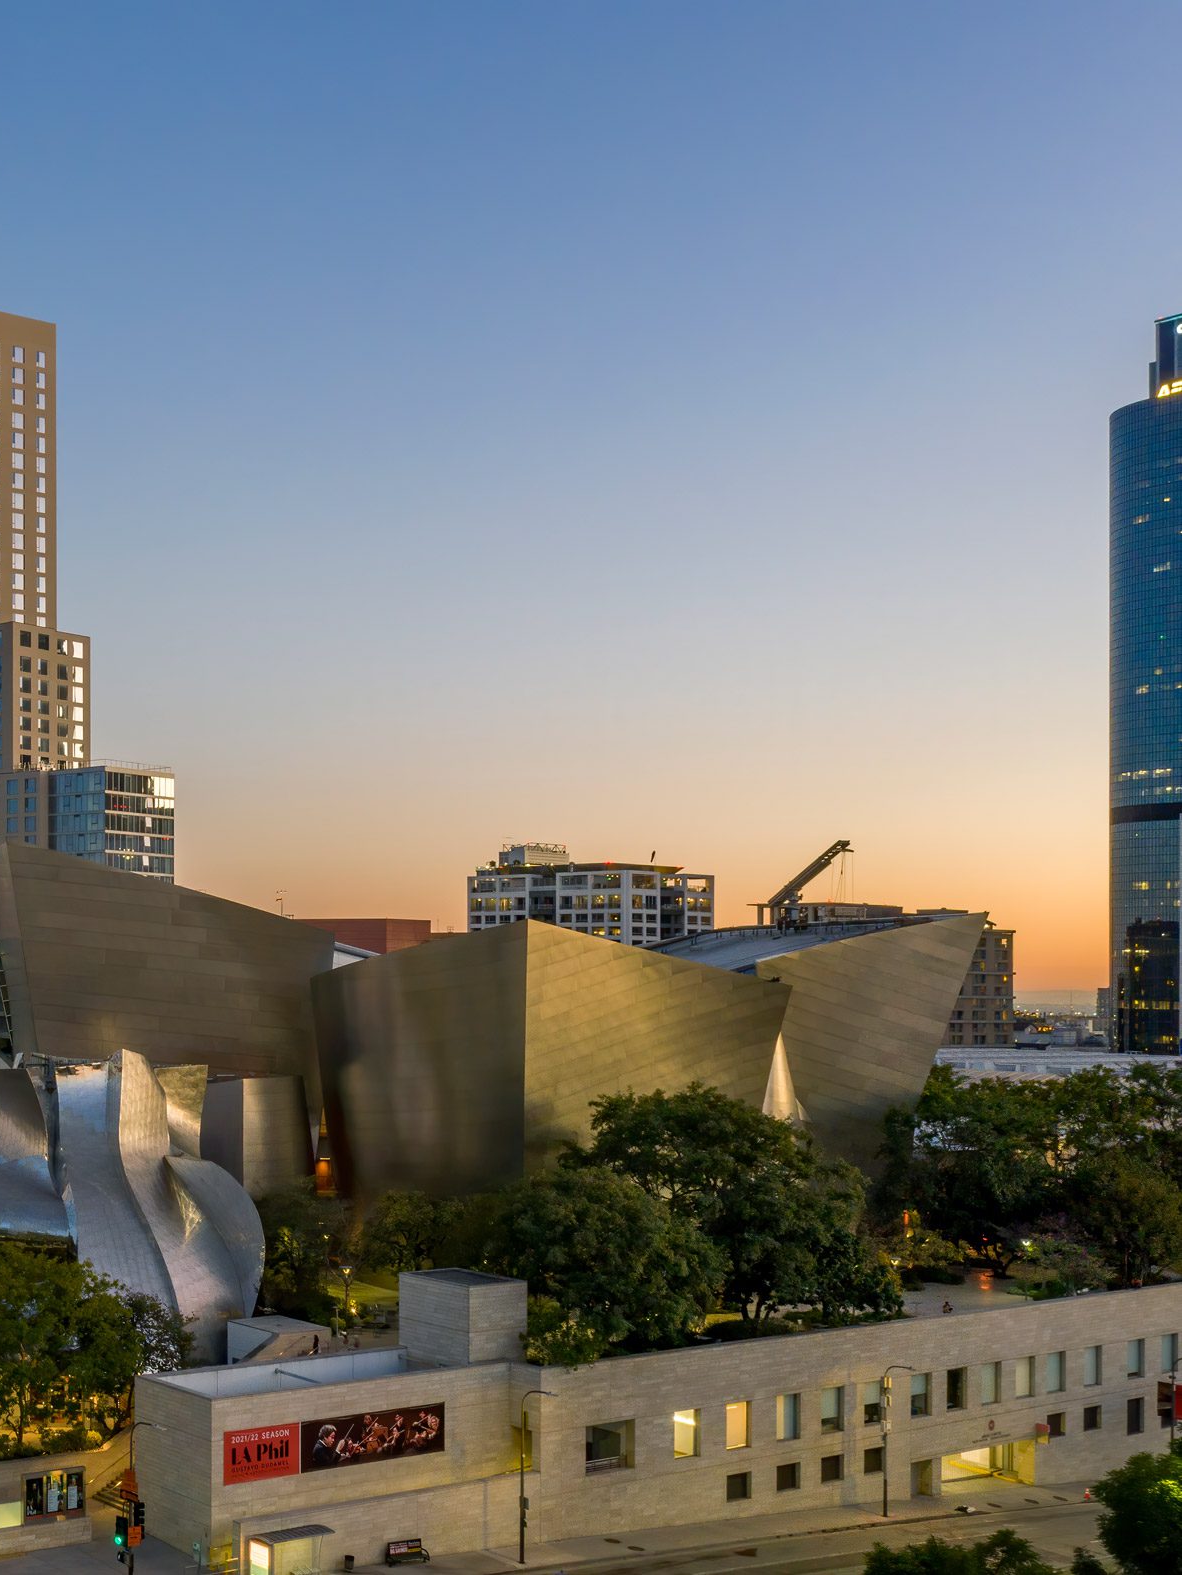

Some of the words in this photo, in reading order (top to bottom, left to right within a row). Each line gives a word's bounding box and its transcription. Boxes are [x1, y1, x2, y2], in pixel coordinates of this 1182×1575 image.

[231, 1433, 258, 1444] 2021/22
[261, 1429, 290, 1440] SEASON
[231, 1446, 252, 1465] LA
[256, 1440, 289, 1461] Phil
[231, 1464, 259, 1473] GUSTAVO
